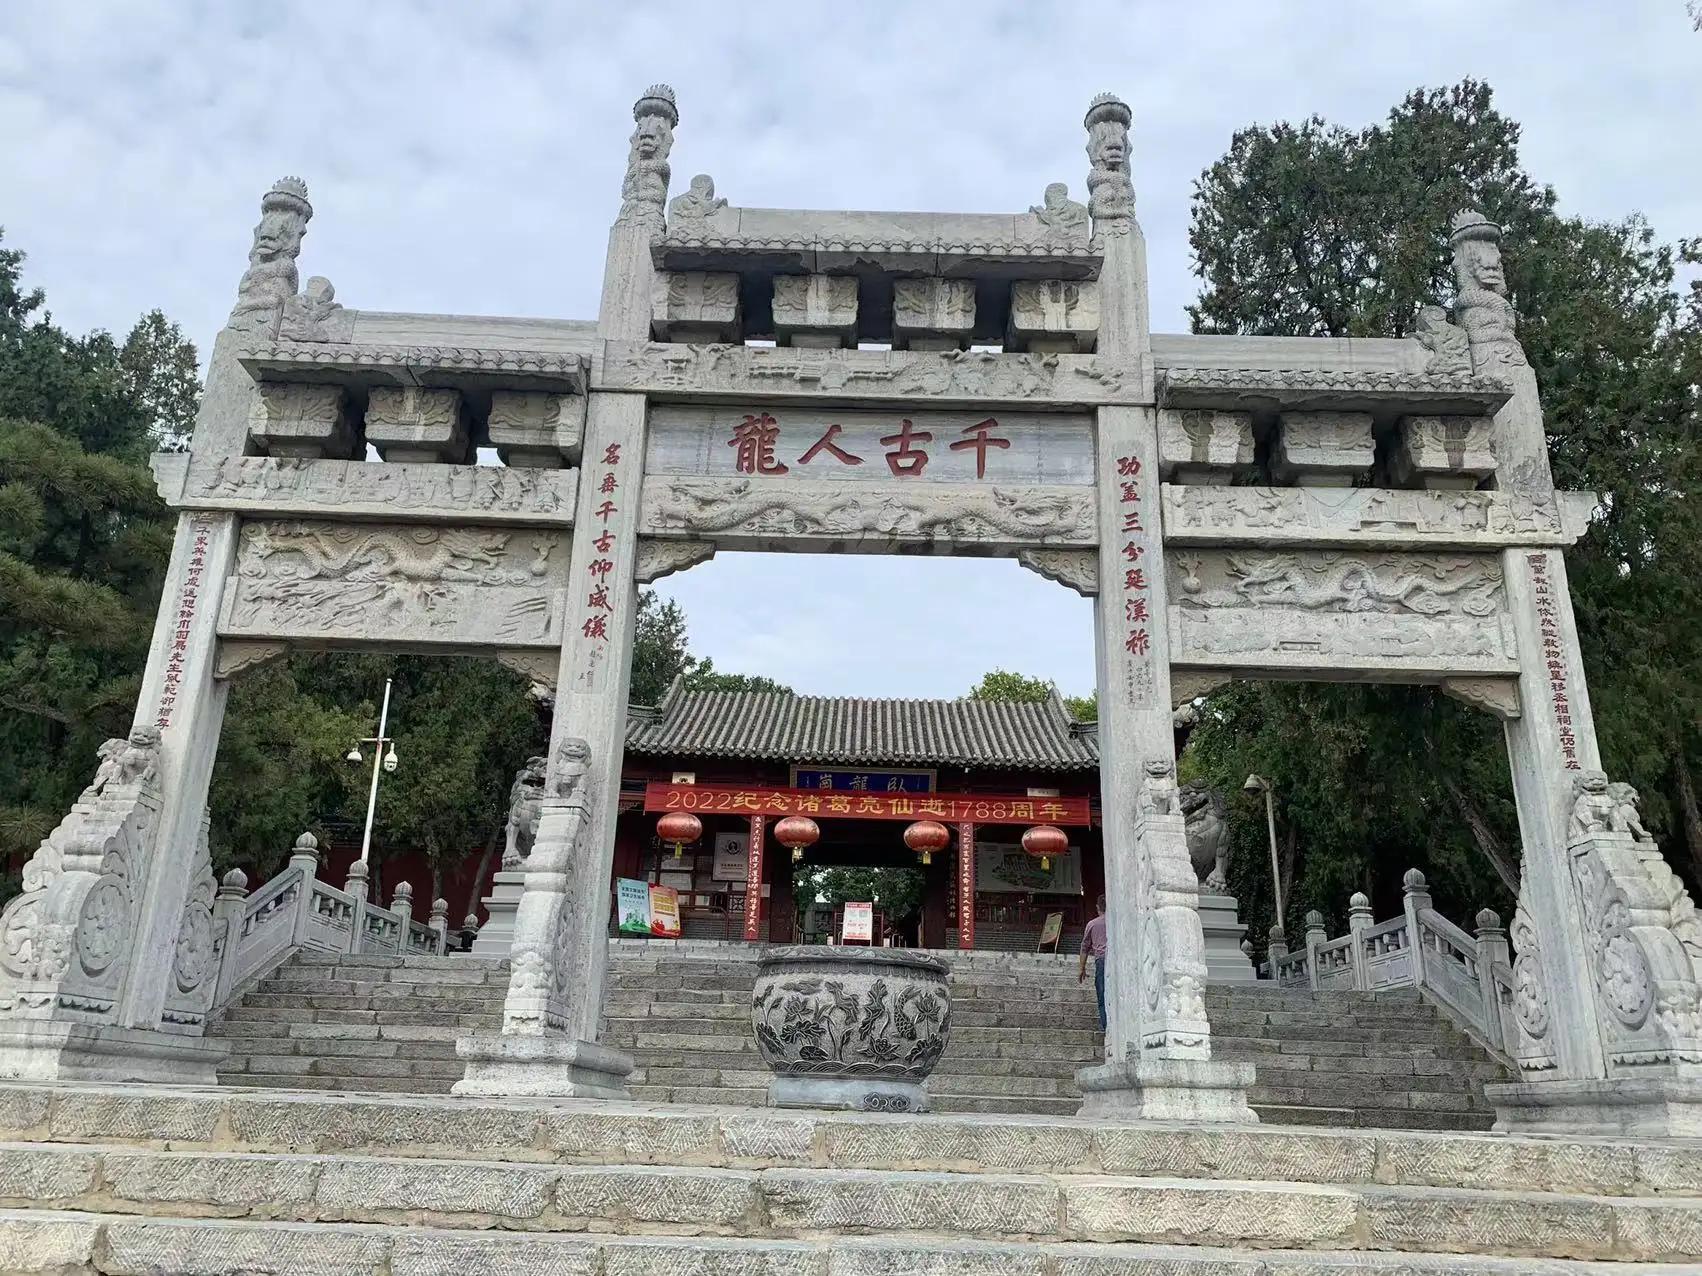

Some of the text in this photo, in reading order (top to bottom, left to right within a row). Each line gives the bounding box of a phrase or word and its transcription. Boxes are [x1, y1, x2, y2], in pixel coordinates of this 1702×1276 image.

[727, 411, 1011, 479] 千古人龍
[666, 791, 1068, 820] 2022纪念诸葛亮仙逝1788周年
